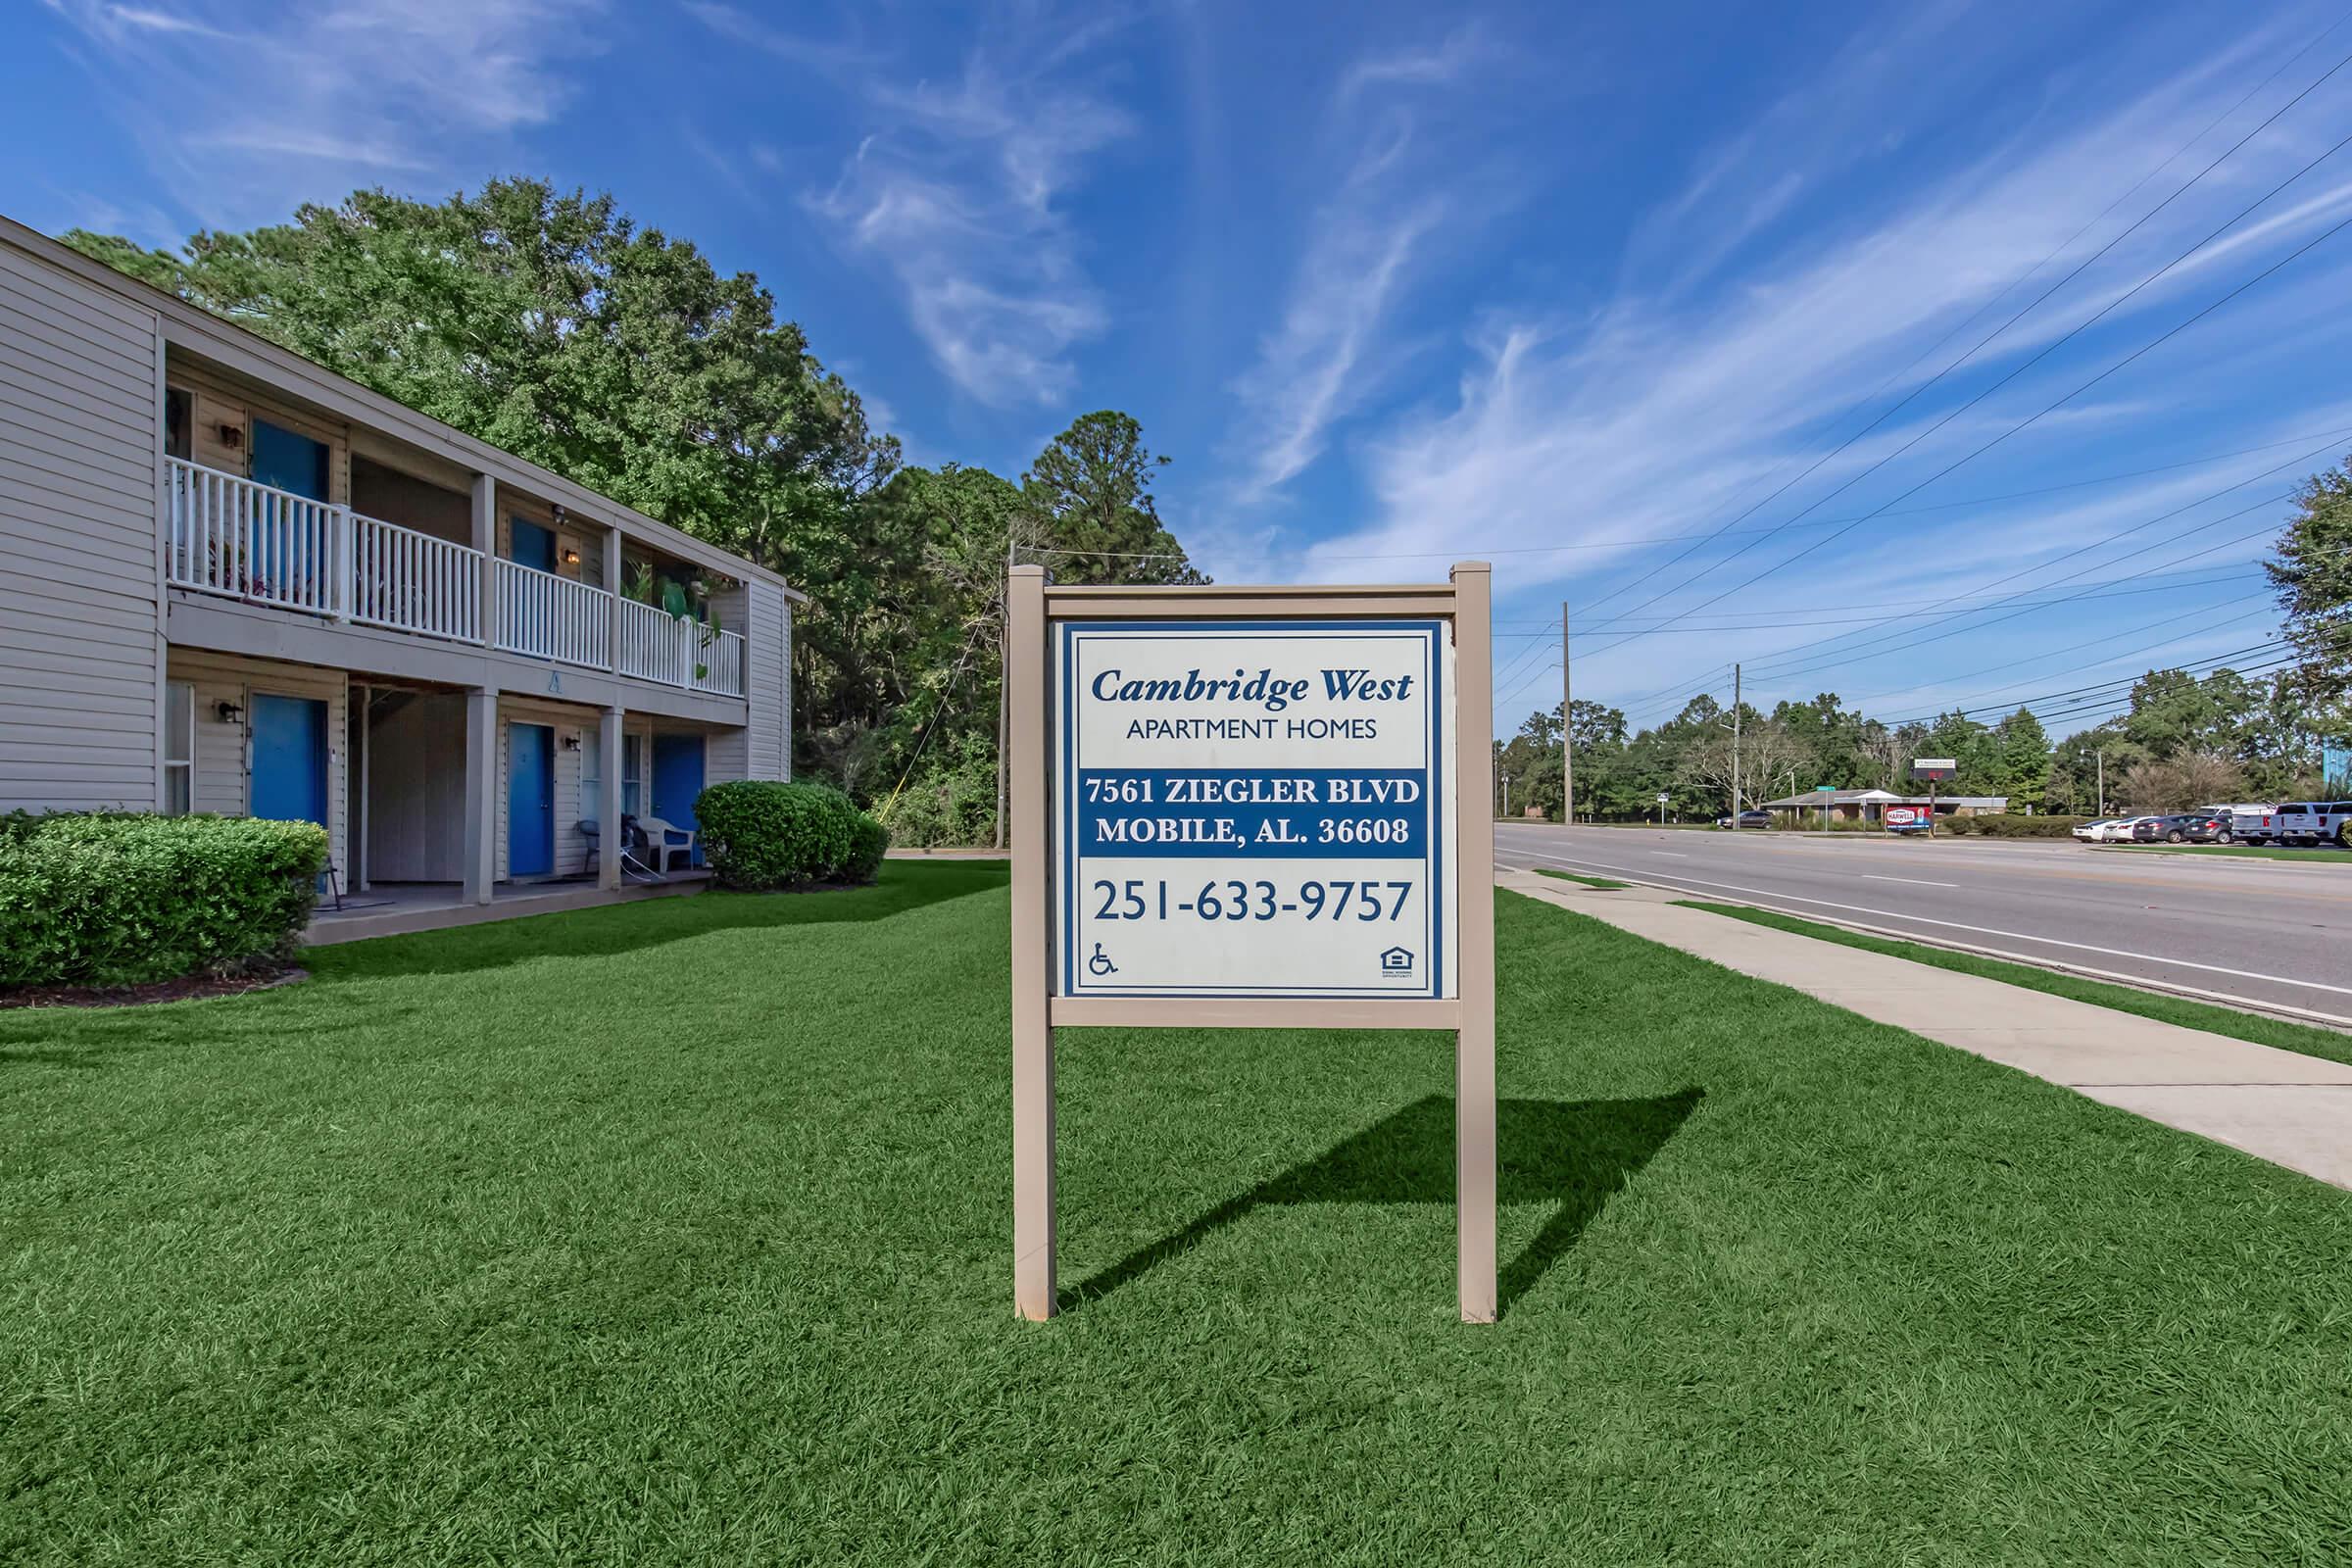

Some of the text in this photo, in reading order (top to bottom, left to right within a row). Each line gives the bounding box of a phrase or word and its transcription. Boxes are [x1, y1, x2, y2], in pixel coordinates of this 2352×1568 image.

[1091, 668, 1414, 711] Cambridge West
[1126, 718, 1377, 740] APARTMENT HOMES
[1085, 777, 1420, 804] 7561 ZIEGLER BLVD
[1096, 818, 1409, 849] MOBILE, AL. 36608
[1094, 879, 1413, 922] 251-633-9757
